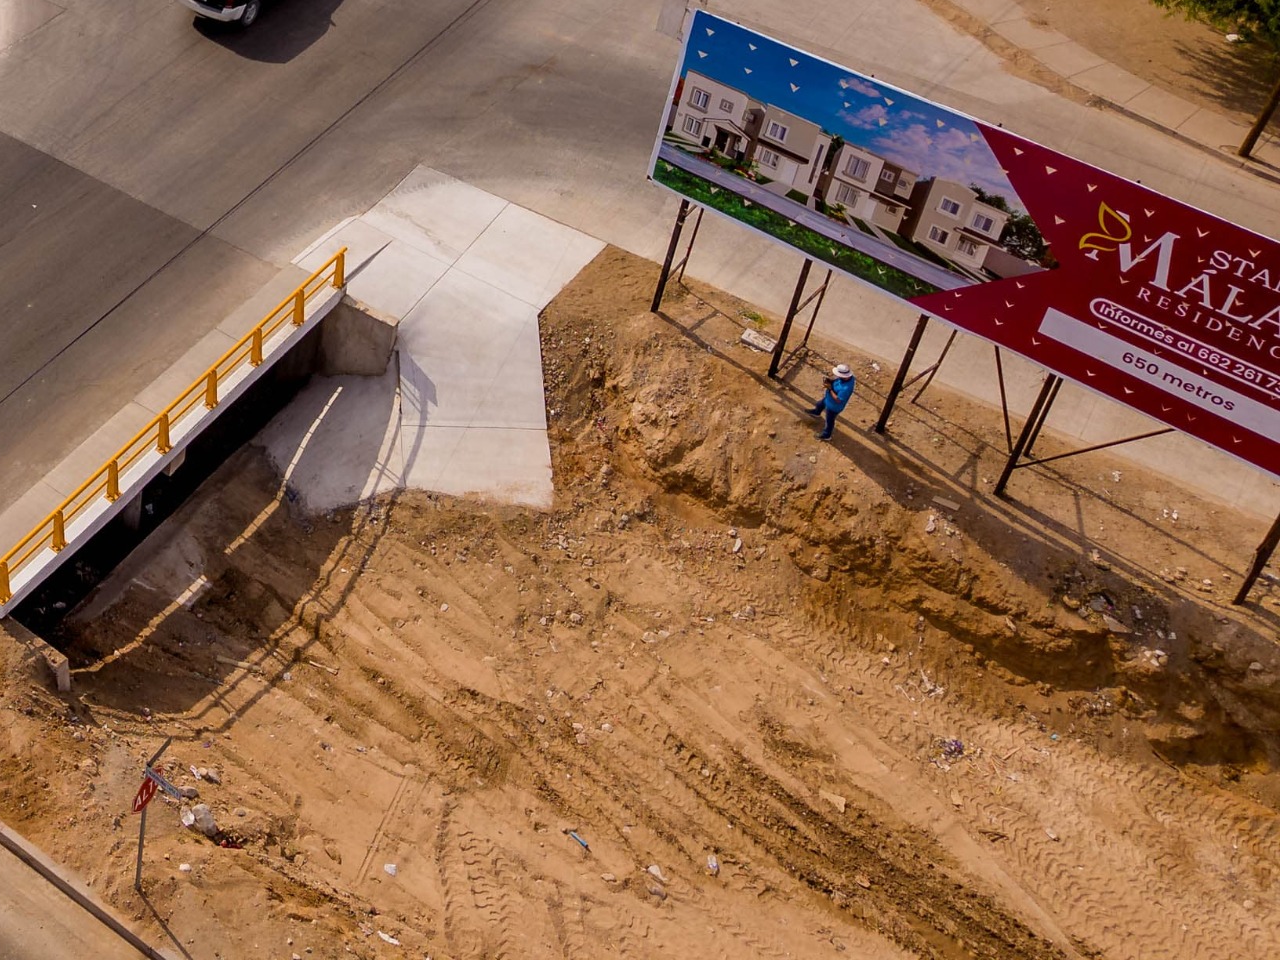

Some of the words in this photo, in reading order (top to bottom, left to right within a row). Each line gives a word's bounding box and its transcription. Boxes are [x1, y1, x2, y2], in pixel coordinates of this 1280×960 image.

[1099, 303, 1175, 344] Informes
[1177, 339, 1195, 354] al
[1198, 348, 1231, 369] 662
[1233, 363, 1263, 383] 261
[1122, 352, 1159, 375] 650
[1162, 372, 1235, 411] metros
[135, 779, 158, 810] ALT
